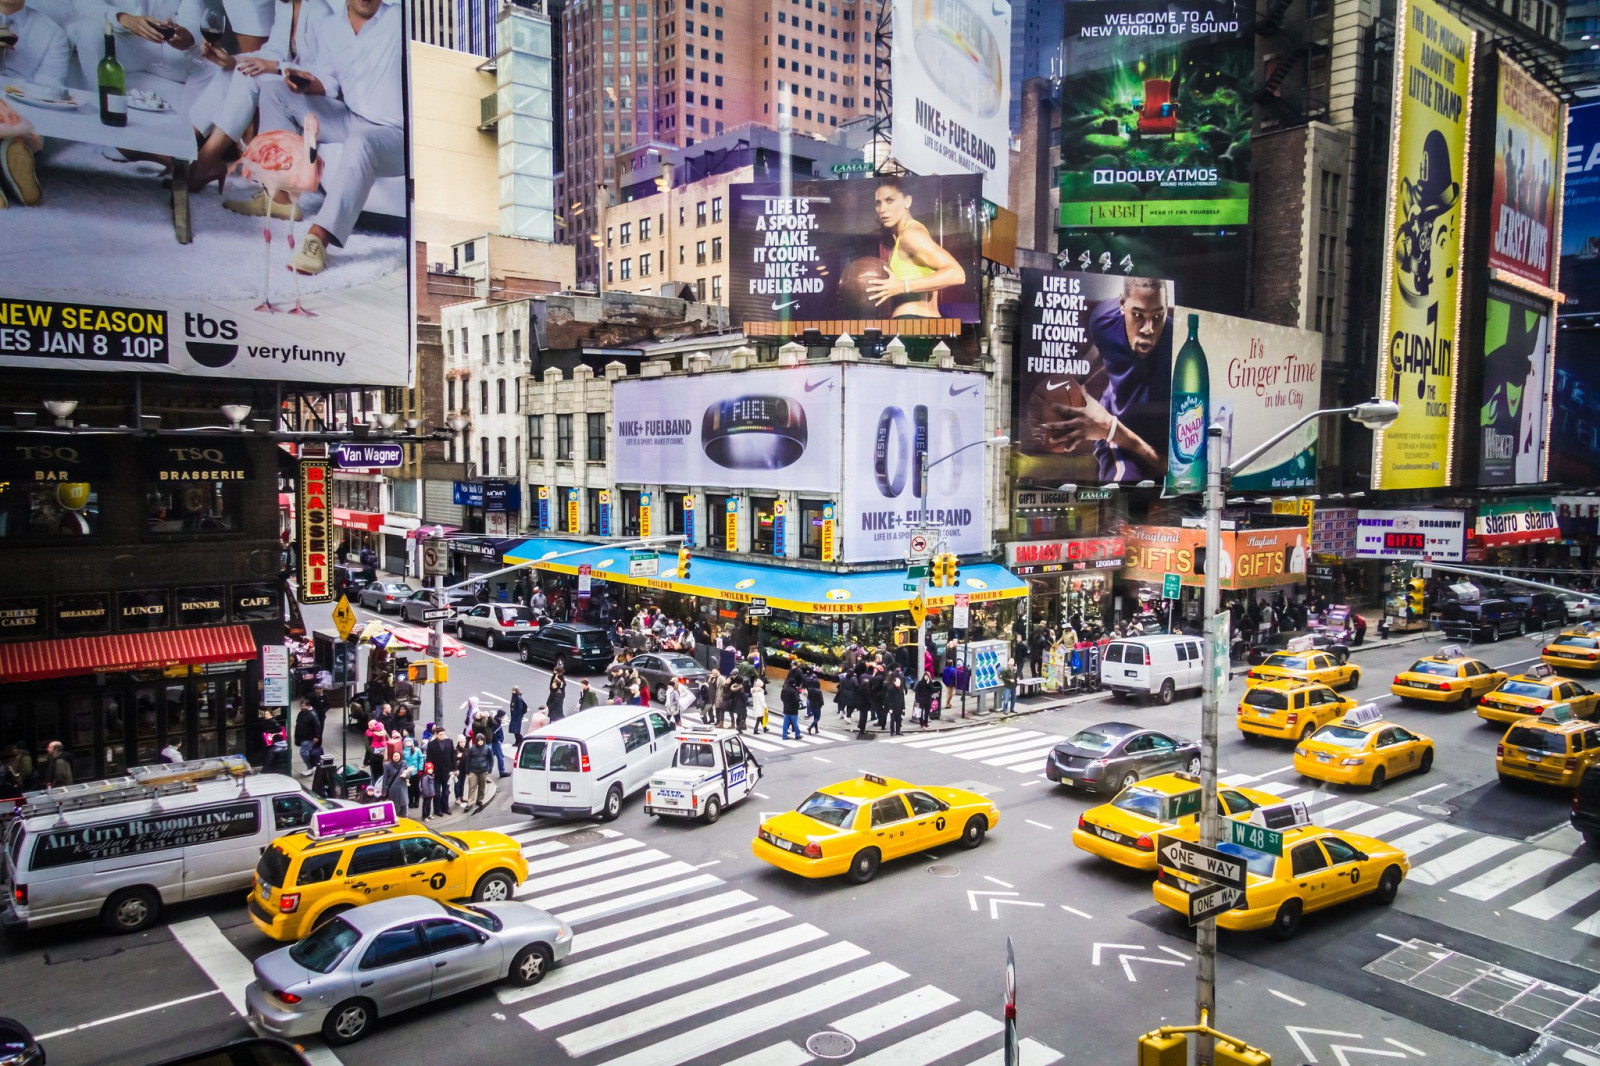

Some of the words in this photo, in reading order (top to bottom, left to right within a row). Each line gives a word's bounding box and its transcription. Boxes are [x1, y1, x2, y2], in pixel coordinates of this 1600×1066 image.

[1105, 12, 1176, 25] WELCOME
[1182, 11, 1200, 22] TO
[1204, 11, 1214, 22] A
[1081, 26, 1113, 37] NEW
[1117, 24, 1165, 36] WORLD
[1169, 23, 1187, 34] OF
[1191, 22, 1238, 33] SOUND
[1412, 5, 1424, 34] THE
[1426, 15, 1437, 43] BIG
[1439, 25, 1465, 63] MUSICAL
[1420, 42, 1443, 77] ABOUT
[1444, 58, 1455, 85] THE
[1409, 65, 1432, 108] LITTLE
[1433, 81, 1462, 124] TRAMP
[916, 97, 946, 136] NIKE+
[949, 119, 996, 170] FUELBAND
[1116, 169, 1165, 183] DOLBY
[1168, 169, 1217, 182] ATMOS
[765, 199, 793, 215] LIFE
[796, 199, 809, 215] IS
[755, 216, 767, 230] A
[769, 214, 819, 230] SPORT.
[765, 231, 808, 246] MAKE
[1495, 203, 1530, 264] JERSEY
[1528, 219, 1548, 272] BOYS
[754, 248, 766, 262] IT
[768, 247, 819, 262] COUNT.
[765, 262, 808, 278] NIKE+
[749, 279, 824, 294] FUELBAND
[1042, 276, 1067, 293] LIFE
[1069, 278, 1080, 293] IS
[1034, 292, 1044, 308] A
[1045, 294, 1087, 311] SPORT.
[62, 308, 163, 335] SEASON
[185, 312, 238, 340] tbs
[1041, 309, 1079, 326] MAKE
[1032, 324, 1044, 340] IT
[1044, 325, 1088, 343] COUNT.
[39, 331, 84, 354] JAN
[93, 334, 108, 356] 8
[121, 336, 164, 358] 10P
[1041, 341, 1078, 358] NIKE+
[1249, 337, 1264, 359] It's
[248, 345, 346, 366] veryfunny
[1027, 357, 1090, 375] FUELBAND
[1228, 358, 1280, 397] Ginger
[1284, 353, 1316, 384] Time
[1265, 391, 1274, 408] in
[1275, 390, 1286, 407] the
[1288, 388, 1304, 409] City
[733, 400, 770, 421] FUEL
[619, 421, 643, 437] NIKE+
[645, 419, 692, 436] FUELBAND
[1184, 432, 1200, 449] DRY
[16, 445, 80, 463] TSQ
[169, 448, 226, 464] TSQ
[343, 447, 361, 462] Van
[364, 447, 399, 463] Wagner
[35, 471, 68, 480] BAR
[160, 470, 245, 480] BRASSERIE
[1018, 494, 1036, 504] GIFTS
[1041, 493, 1069, 503] LUGGAGE
[862, 511, 903, 530] NIKE+
[1419, 520, 1461, 528] BROADWAY
[1486, 510, 1518, 534] sbarro
[1525, 506, 1554, 531] sbarro
[307, 468, 326, 595] BRASSERIE
[874, 532, 885, 541] LIFE
[887, 532, 892, 540] IS
[893, 531, 897, 540] A
[1387, 534, 1423, 547] GIFTS
[1016, 544, 1062, 563] EMBASSY
[1067, 539, 1124, 559] GIFTS
[1125, 546, 1192, 573] GIFTS
[923, 567, 928, 576] 7
[1096, 559, 1121, 567] LUGGAGE
[1237, 551, 1284, 577] GIFTS
[123, 605, 163, 616] LUNCH
[181, 601, 220, 610] DINNER
[240, 597, 270, 607] CAFE
[812, 603, 863, 612] SMILER'S
[0, 608, 38, 618] CHEESE
[2, 616, 36, 627] CAKES
[60, 608, 106, 618] BREAKFAST
[730, 770, 744, 783] NYPD
[1173, 796, 1182, 815] 7
[1188, 795, 1195, 803] AV
[45, 834, 77, 850] ALL
[83, 827, 124, 843] CITY
[129, 811, 254, 836] REMODELING.com
[1236, 824, 1245, 844] W
[1250, 828, 1264, 849] 48
[1269, 834, 1279, 844] ST
[1170, 847, 1194, 865] ONE
[1207, 858, 1234, 877] WAY
[1197, 895, 1214, 912] ONE
[1221, 889, 1237, 902] WAY
